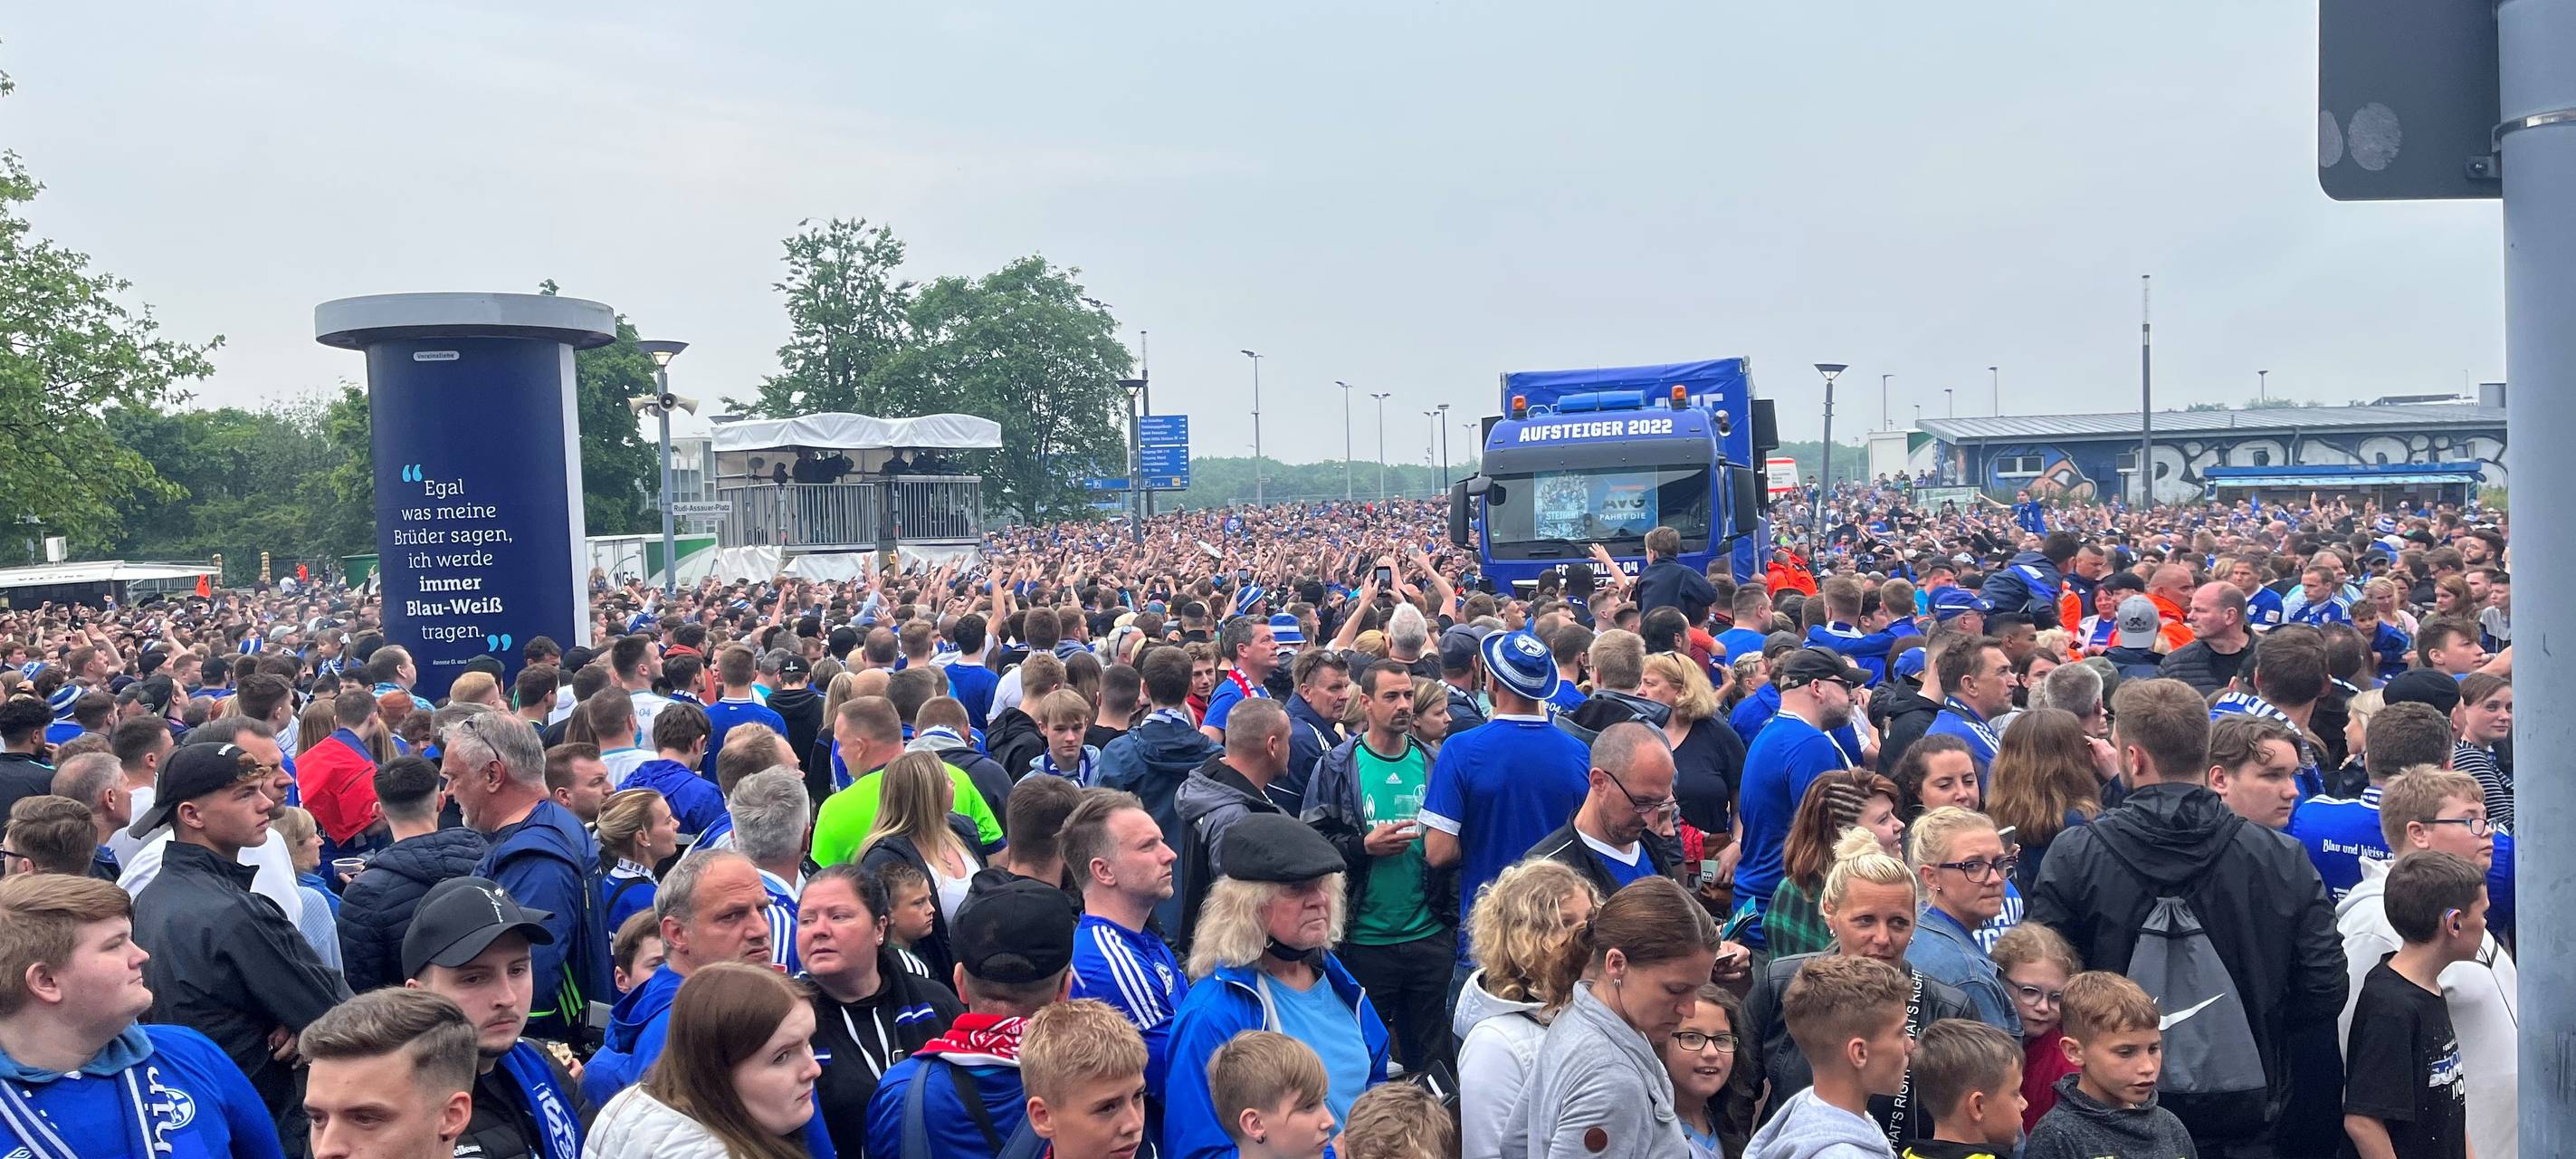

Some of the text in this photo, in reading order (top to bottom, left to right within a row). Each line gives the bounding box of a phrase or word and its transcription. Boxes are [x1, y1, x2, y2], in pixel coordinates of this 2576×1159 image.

[1519, 418, 1673, 443] AUFSTEIGER 2022
[425, 478, 464, 499] Egal
[401, 502, 496, 521] was meine
[673, 503, 730, 512] Rudi-Assauer-Platz
[394, 528, 513, 546] Brüder sagen,
[408, 550, 493, 569] ich werde
[1623, 560, 1639, 573] 04
[419, 575, 482, 591] immer
[406, 597, 503, 616] Blau-Weiß
[421, 625, 485, 643] tragen.
[2323, 838, 2341, 852] Blau
[2342, 843, 2358, 855] und
